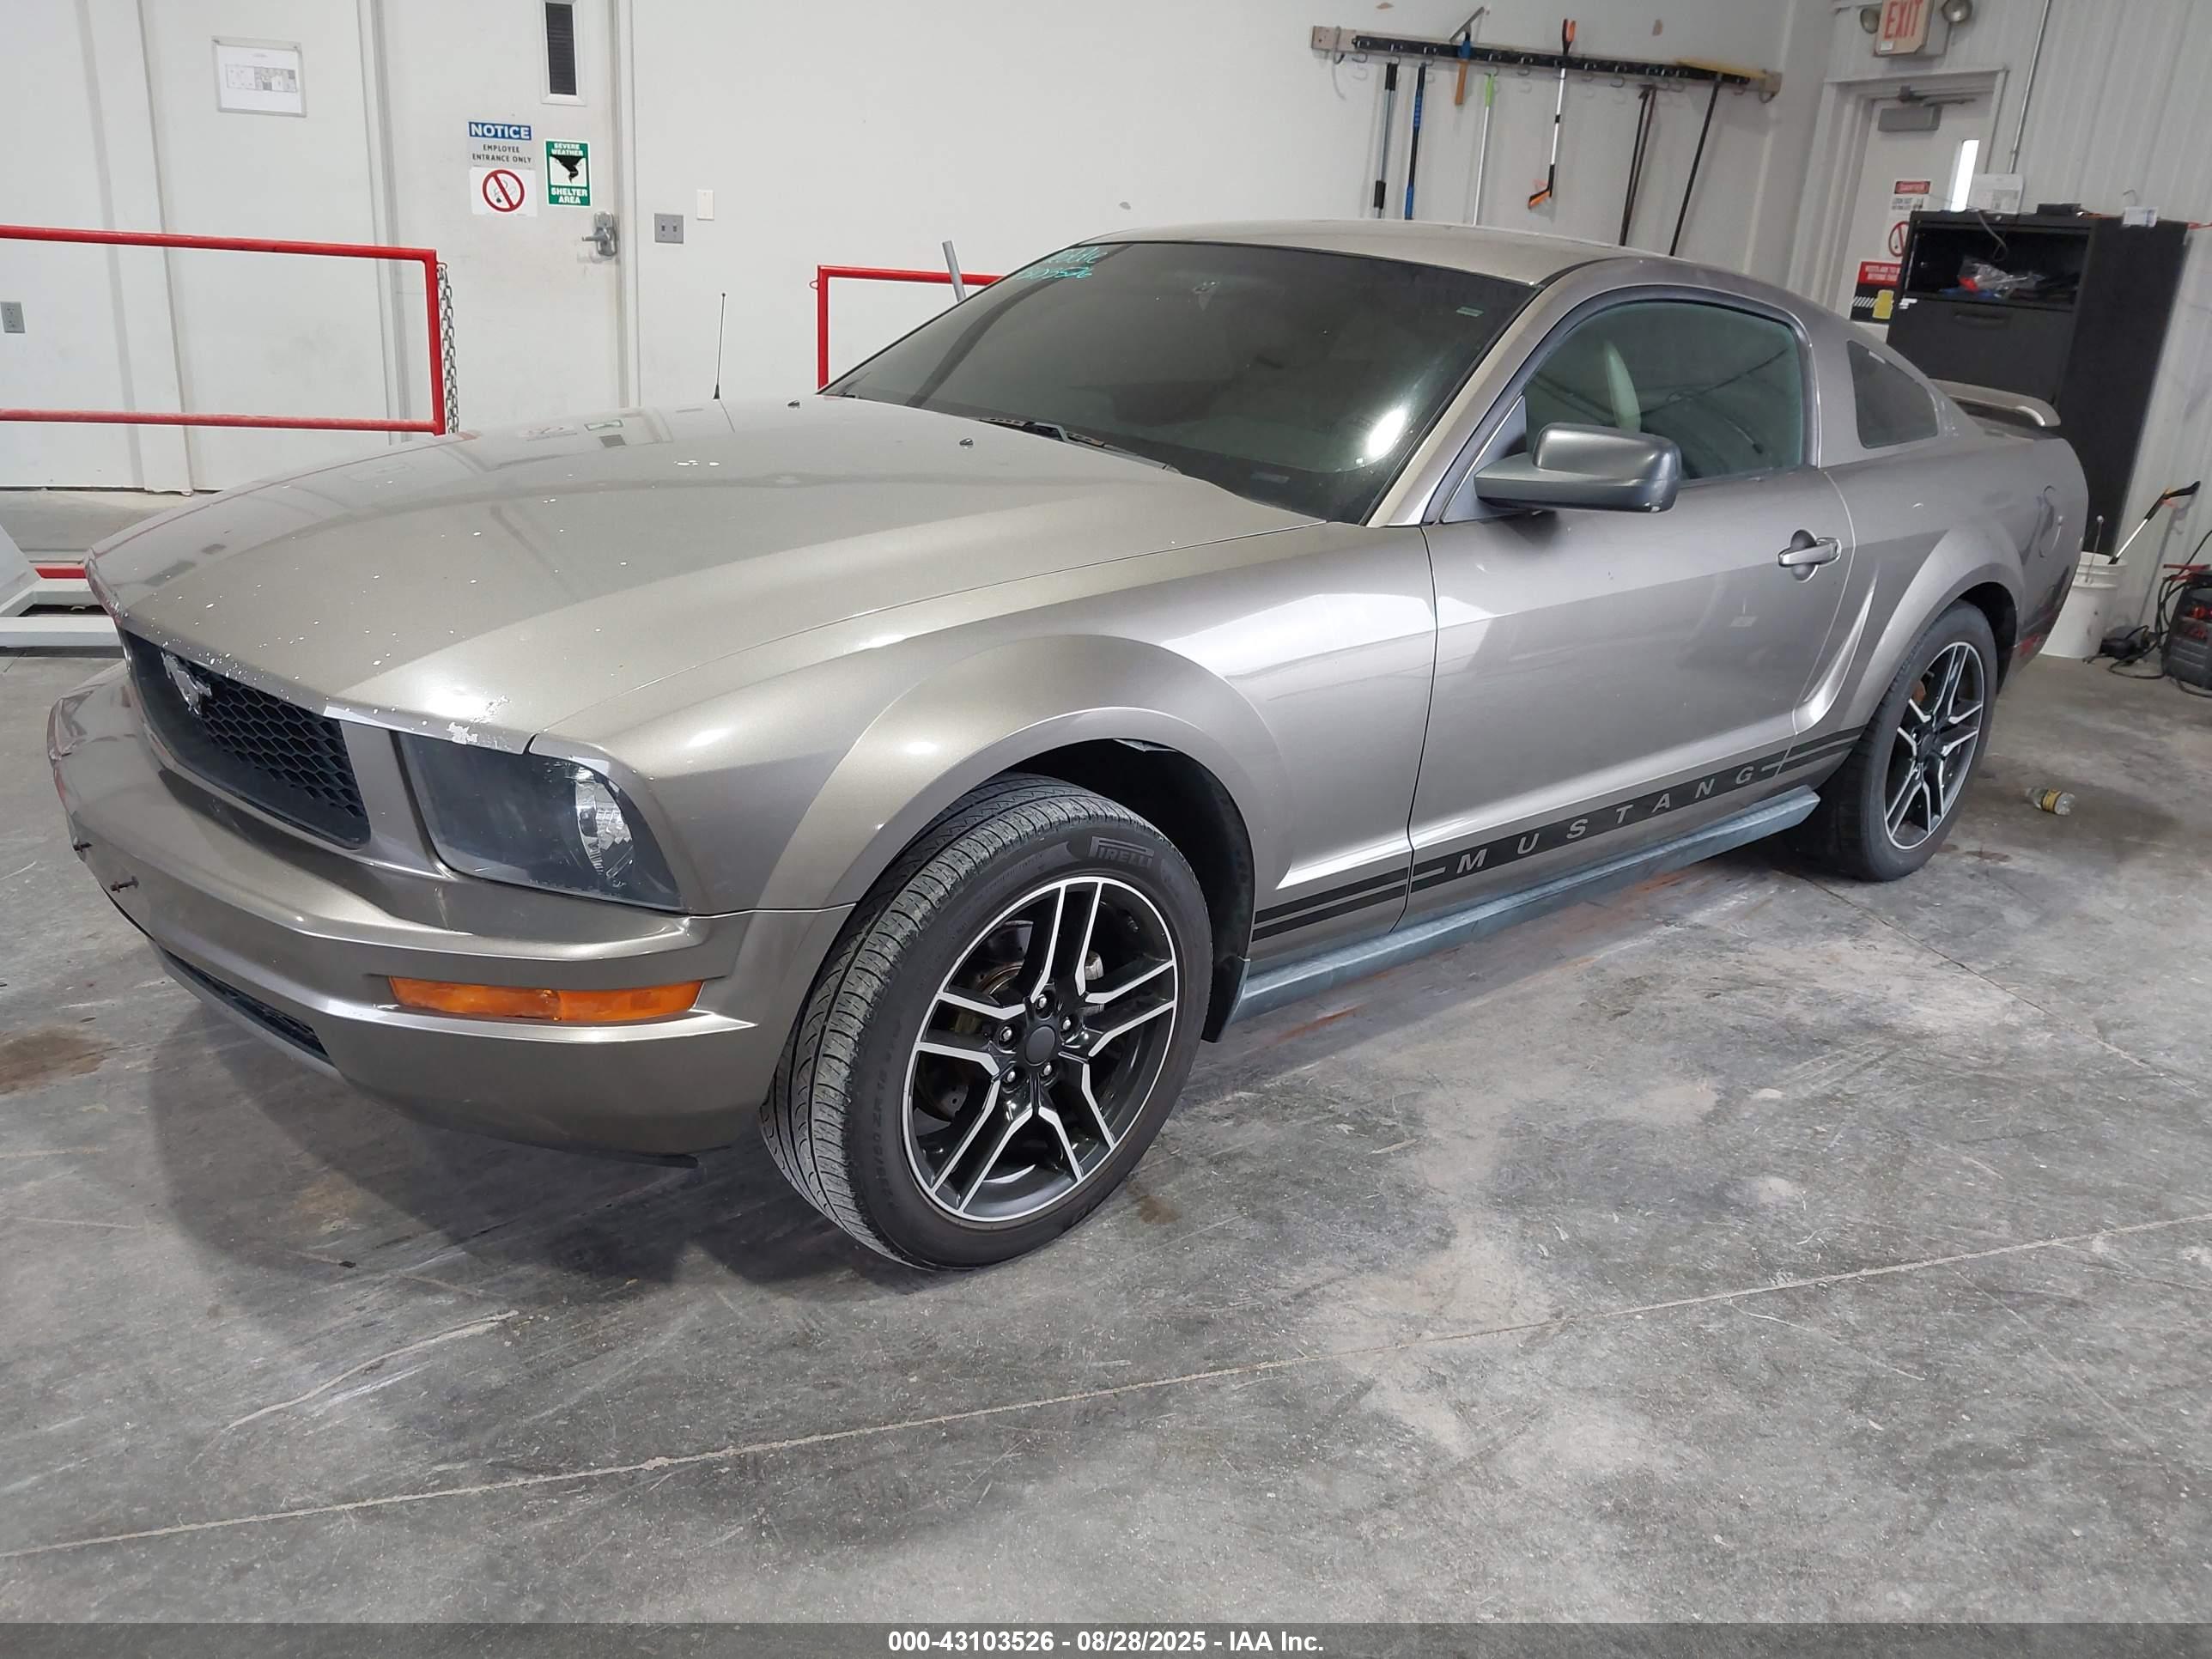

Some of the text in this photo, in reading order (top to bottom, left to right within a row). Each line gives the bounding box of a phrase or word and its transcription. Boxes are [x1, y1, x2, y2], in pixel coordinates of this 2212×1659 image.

[1884, 0, 1923, 40] EXIT
[470, 123, 530, 139] NOTICE
[483, 143, 520, 153] EMPLOYEE
[472, 153, 510, 162] ENTRANCE
[550, 187, 588, 197] SHELTER
[558, 196, 581, 204] AREA
[1455, 765, 1754, 874] MUSTANG
[1087, 836, 1155, 869] PIRELLI
